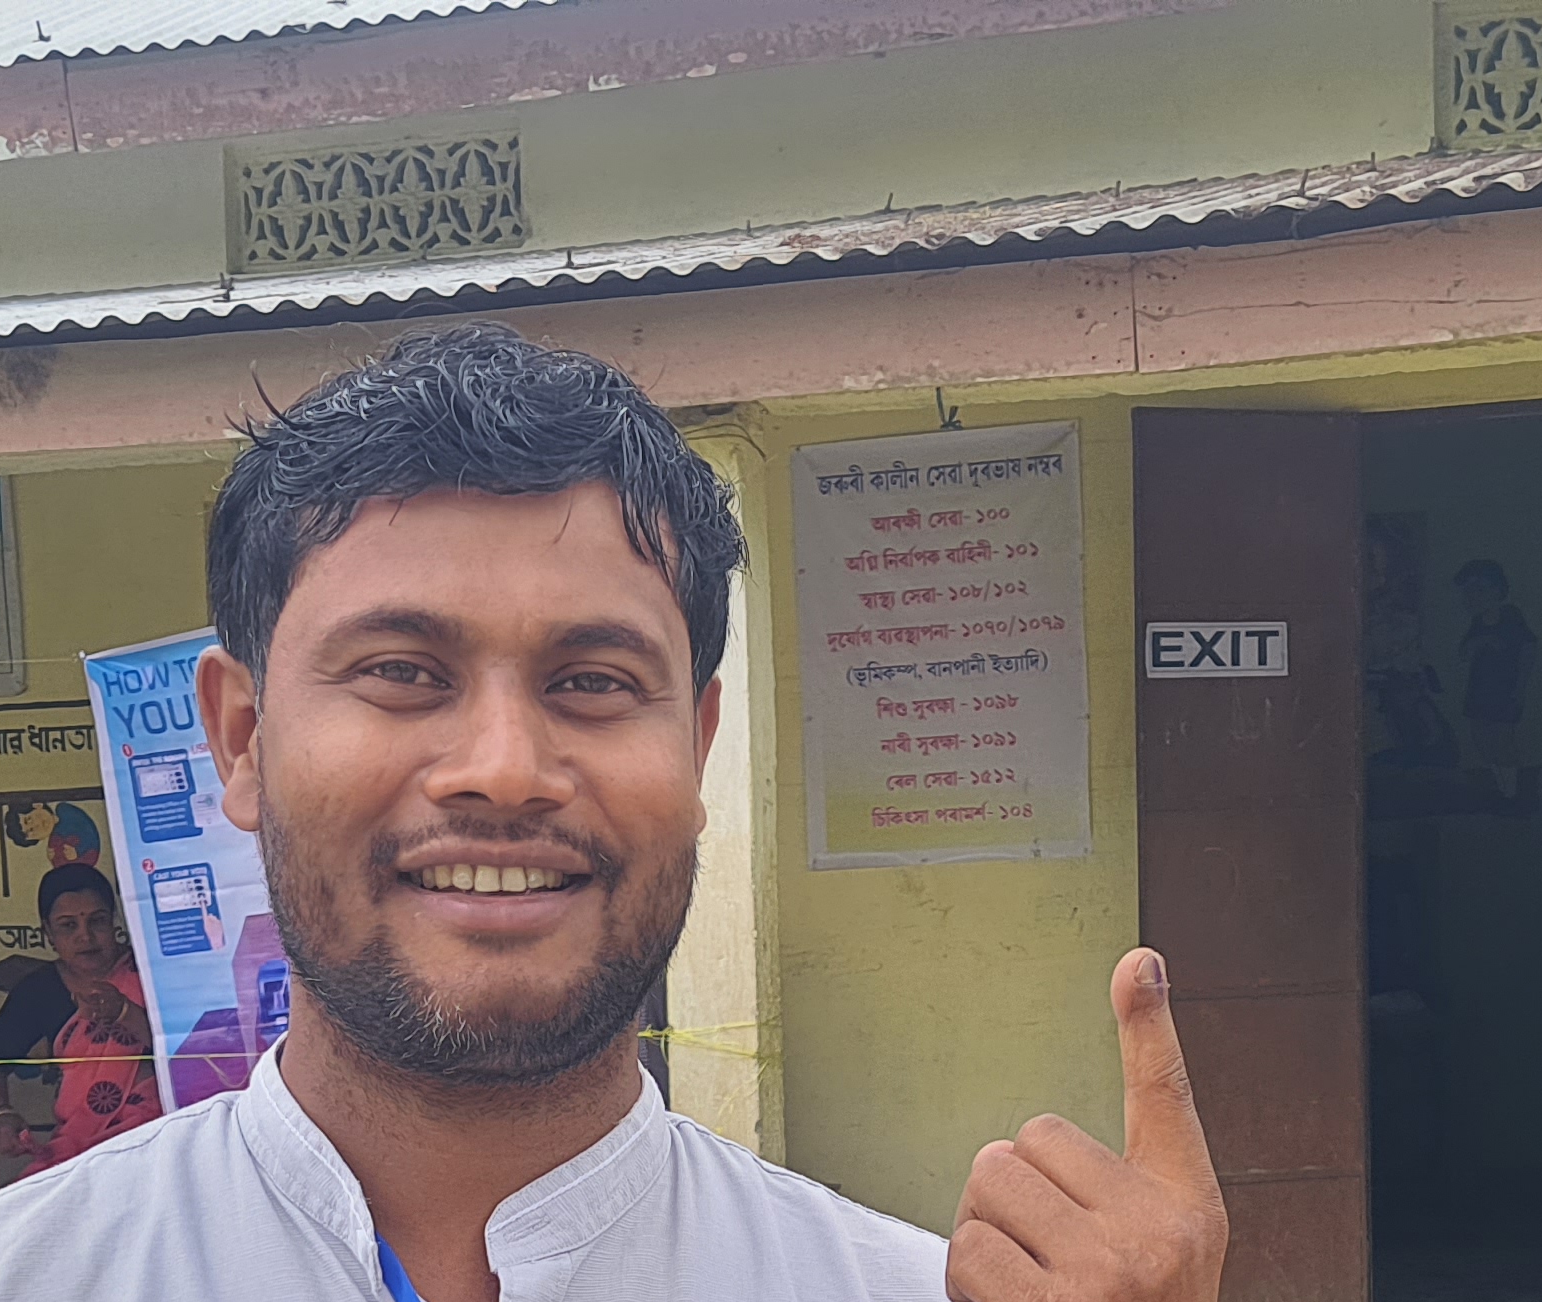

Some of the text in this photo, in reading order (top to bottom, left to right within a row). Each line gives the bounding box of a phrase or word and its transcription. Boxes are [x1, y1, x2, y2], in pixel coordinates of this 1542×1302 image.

[976, 508, 1010, 524] ১০০
[1151, 629, 1280, 668] EXIT
[102, 660, 170, 698] HOW
[113, 693, 202, 738] YOU
